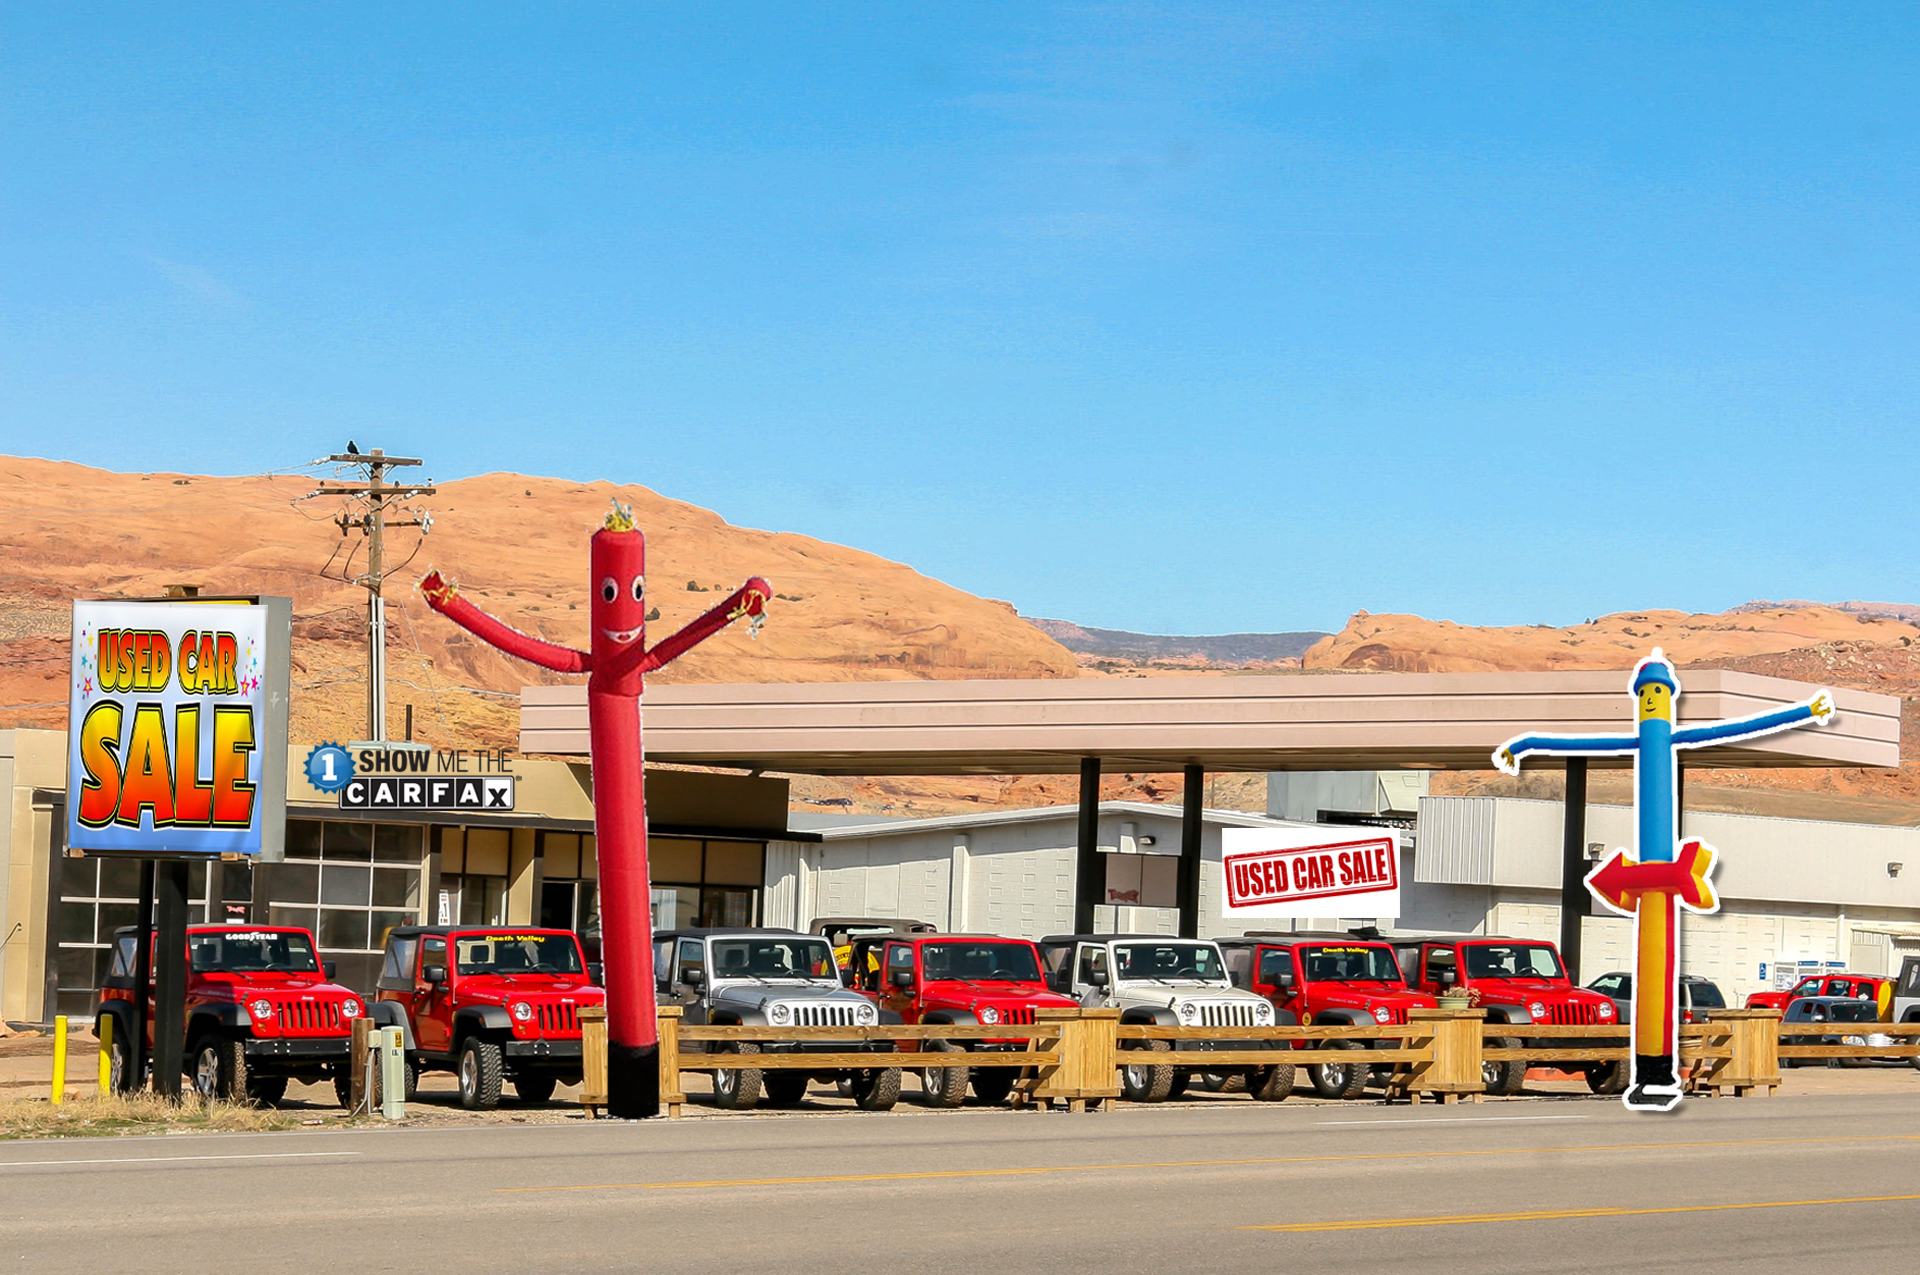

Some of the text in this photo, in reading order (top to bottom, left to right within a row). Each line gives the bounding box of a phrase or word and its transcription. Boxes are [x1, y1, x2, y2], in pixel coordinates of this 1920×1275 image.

[98, 628, 238, 695] USED CAR
[77, 700, 256, 829] SALE
[321, 753, 338, 781] 1
[359, 750, 513, 772] SHOW ME THE
[345, 782, 508, 807] CARFAX
[1234, 848, 1388, 897] USED CAR SALE
[225, 931, 278, 942] GOODYEAR
[516, 935, 545, 943] Valley
